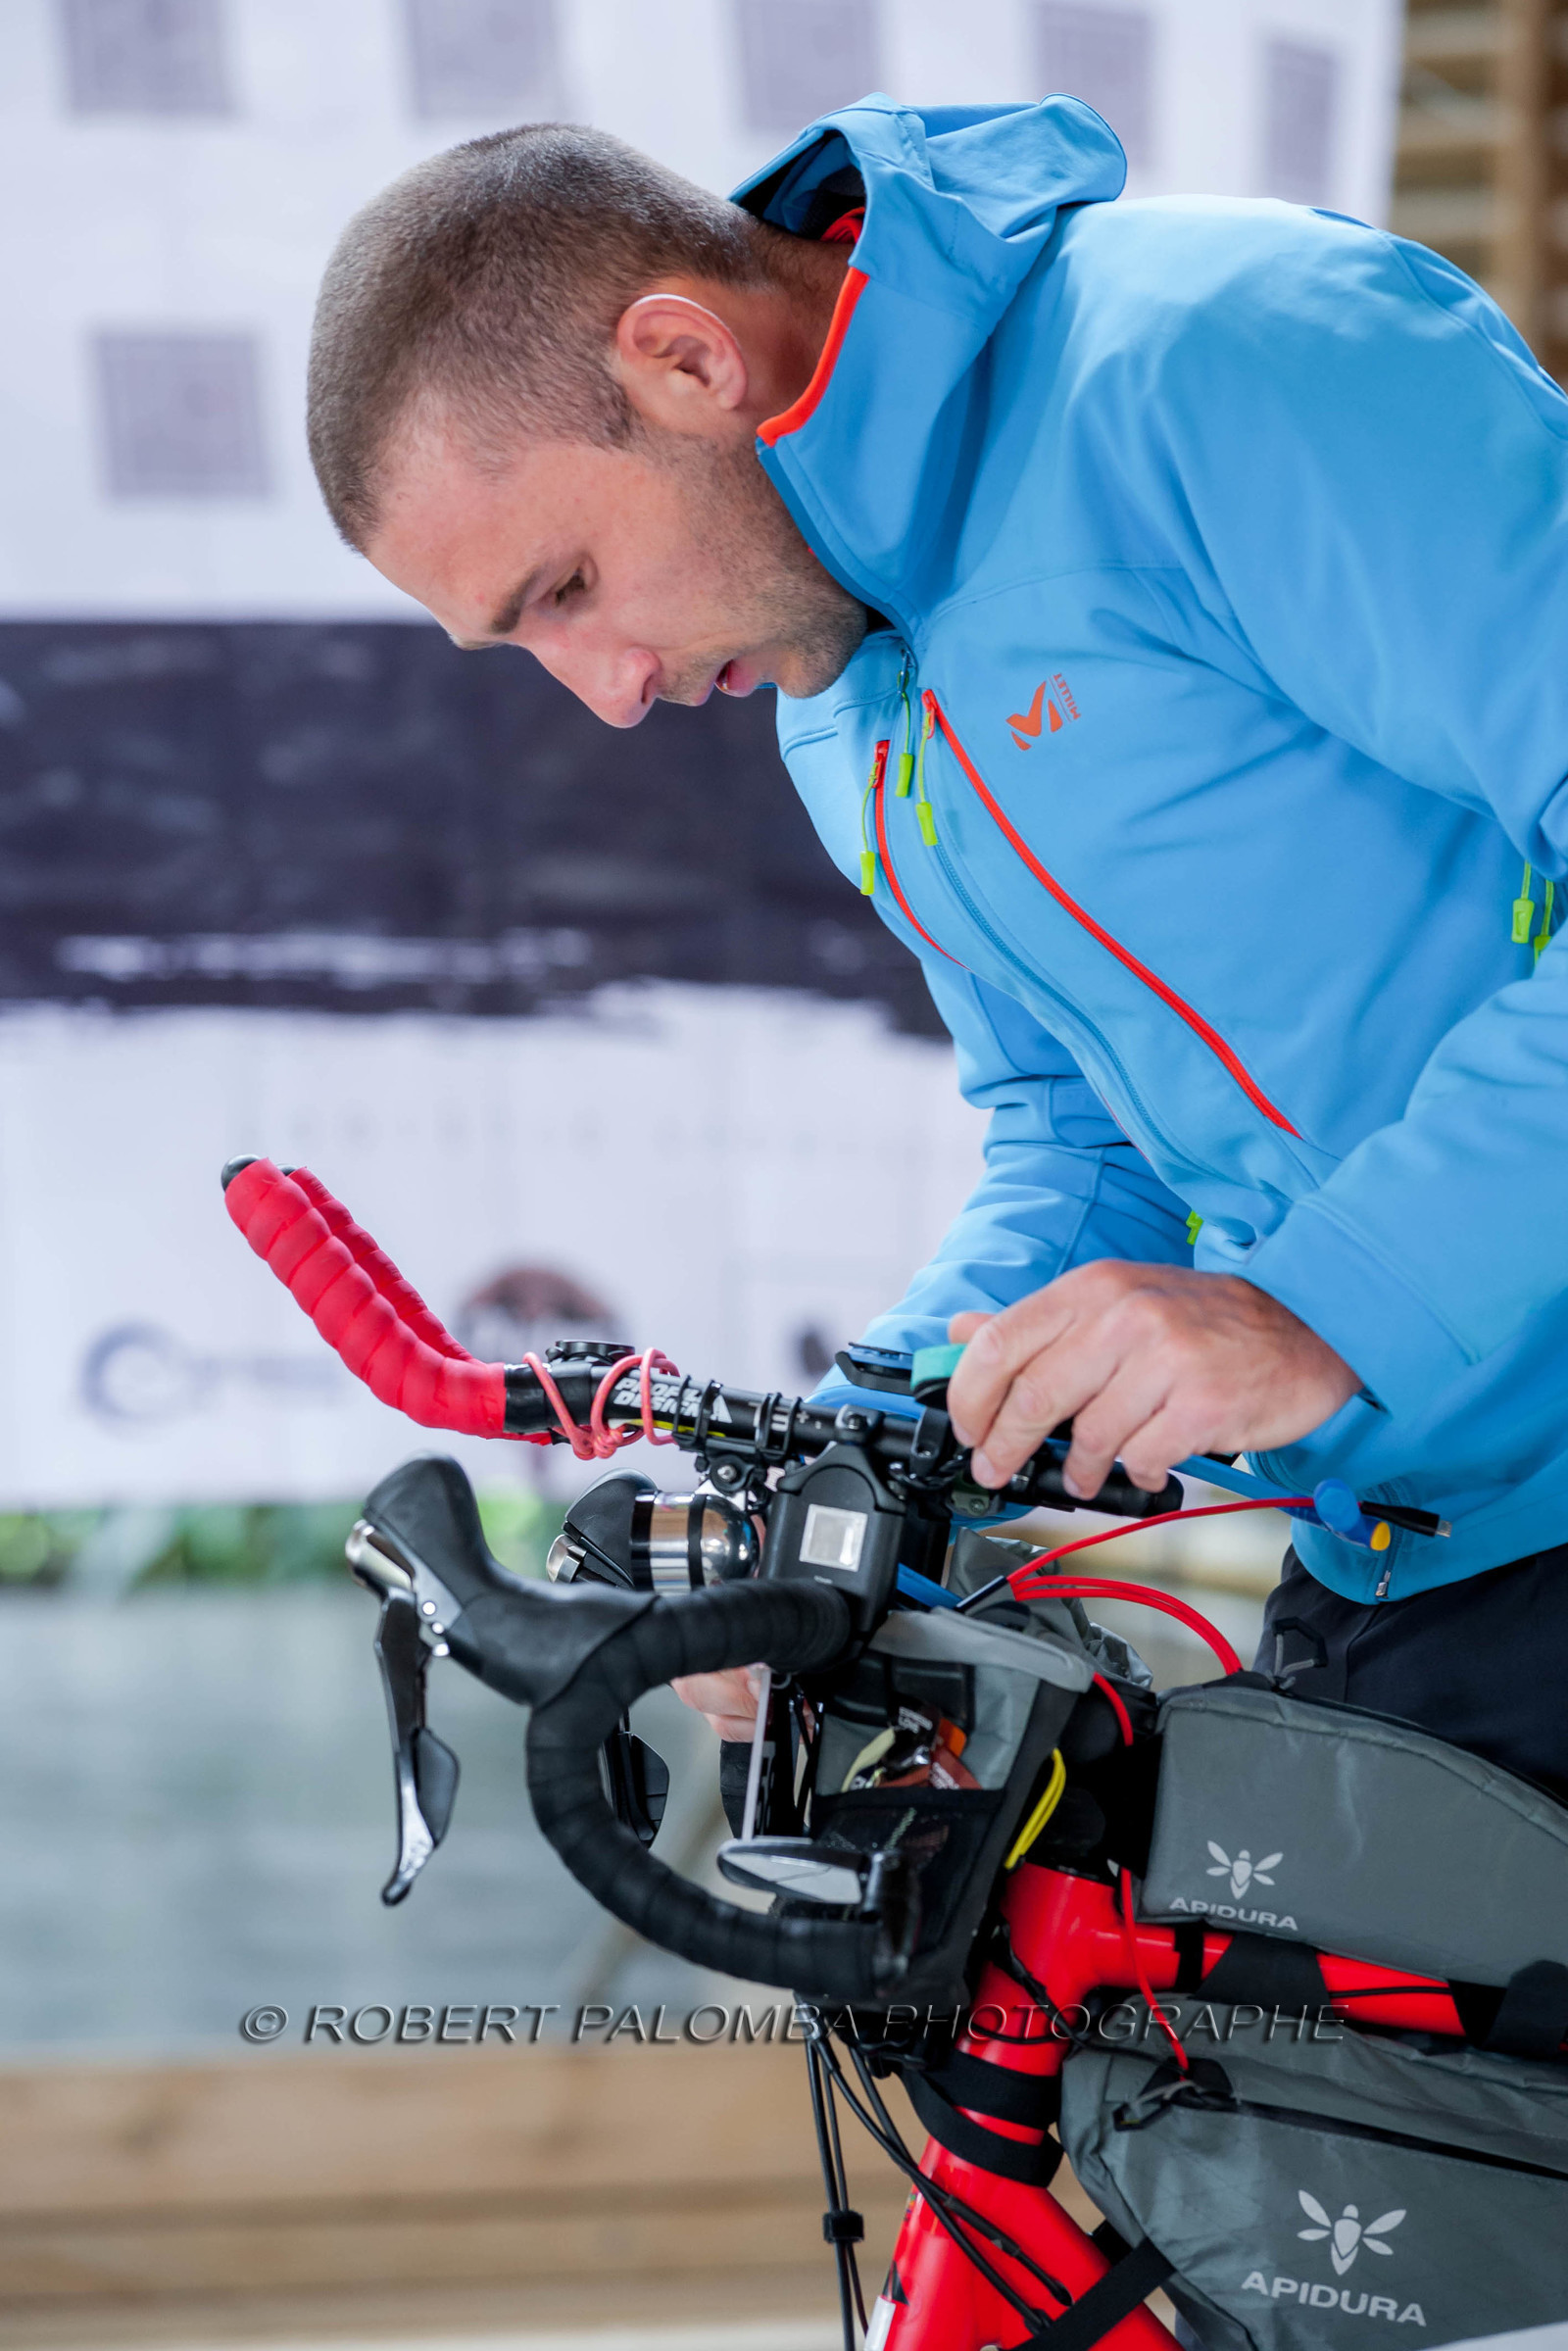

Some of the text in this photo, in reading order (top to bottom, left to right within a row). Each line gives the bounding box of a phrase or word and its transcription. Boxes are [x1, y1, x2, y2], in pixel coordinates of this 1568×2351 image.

[1053, 672, 1082, 720] MILLET
[1169, 1896, 1298, 1931] APIDURA
[1241, 2271, 1427, 2327] APIDURA
